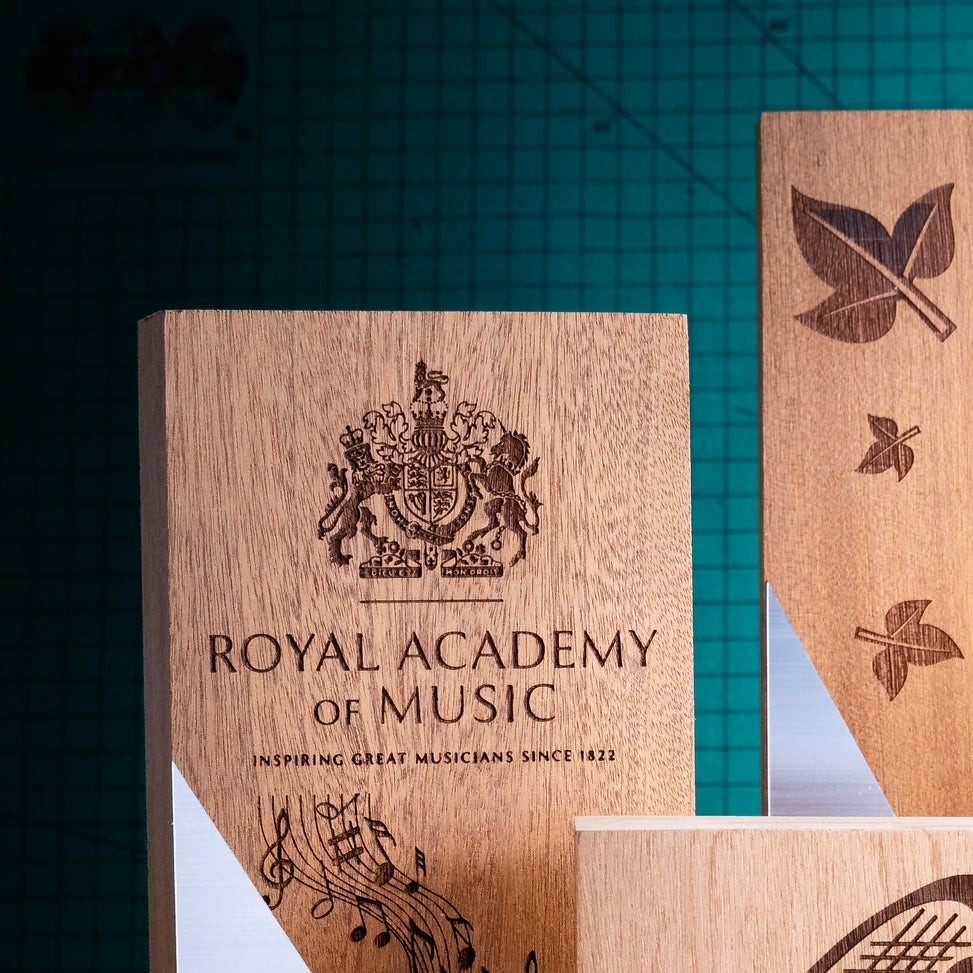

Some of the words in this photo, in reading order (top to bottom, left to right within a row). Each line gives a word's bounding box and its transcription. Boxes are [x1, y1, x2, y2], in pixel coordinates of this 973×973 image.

[208, 633, 380, 675] ROYAL
[399, 629, 658, 671] ACADEMY
[313, 698, 360, 727] OF
[380, 683, 557, 724] MUSIC
[252, 753, 345, 768] INSPIRING
[351, 752, 407, 767] GREAT
[414, 750, 515, 764] MUSICIANS
[521, 749, 573, 762] SINCE
[579, 748, 617, 761] 1822
